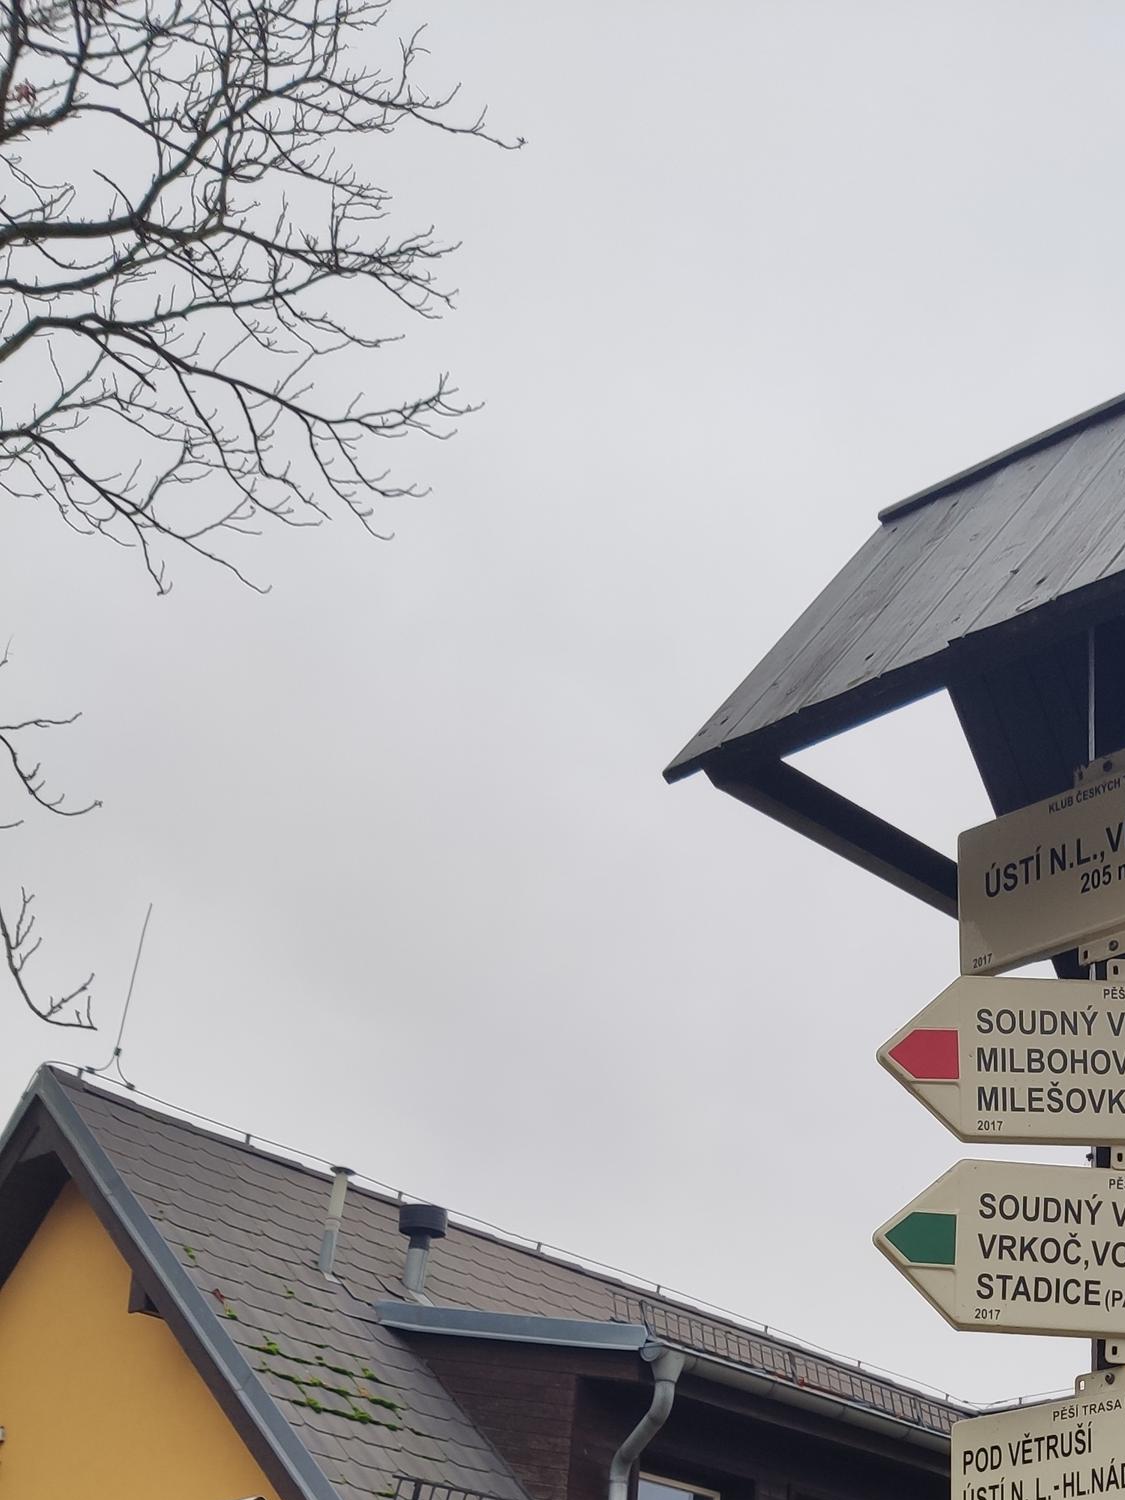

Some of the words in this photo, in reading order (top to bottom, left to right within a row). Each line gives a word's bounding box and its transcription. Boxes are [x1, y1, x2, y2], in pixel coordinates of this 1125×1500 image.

[1048, 798, 1074, 814] KLUB
[1075, 779, 1121, 804] ČESKÝCH
[984, 846, 1041, 898] ÚSTÍ
[1080, 868, 1112, 894] 205
[973, 953, 993, 969] 2017
[976, 1004, 1099, 1038] SOUDNÝ
[977, 1120, 1003, 1132] 2017
[978, 1193, 1104, 1226] SOUDNÝ
[976, 1273, 1102, 1307] STADICE
[974, 1308, 1001, 1320] 2017
[1052, 1403, 1080, 1422] PĚŠÍ
[1082, 1399, 1122, 1418] TRASA
[962, 1444, 1002, 1476] POD
[1008, 1422, 1094, 1469] VĚTRUŠÍ
